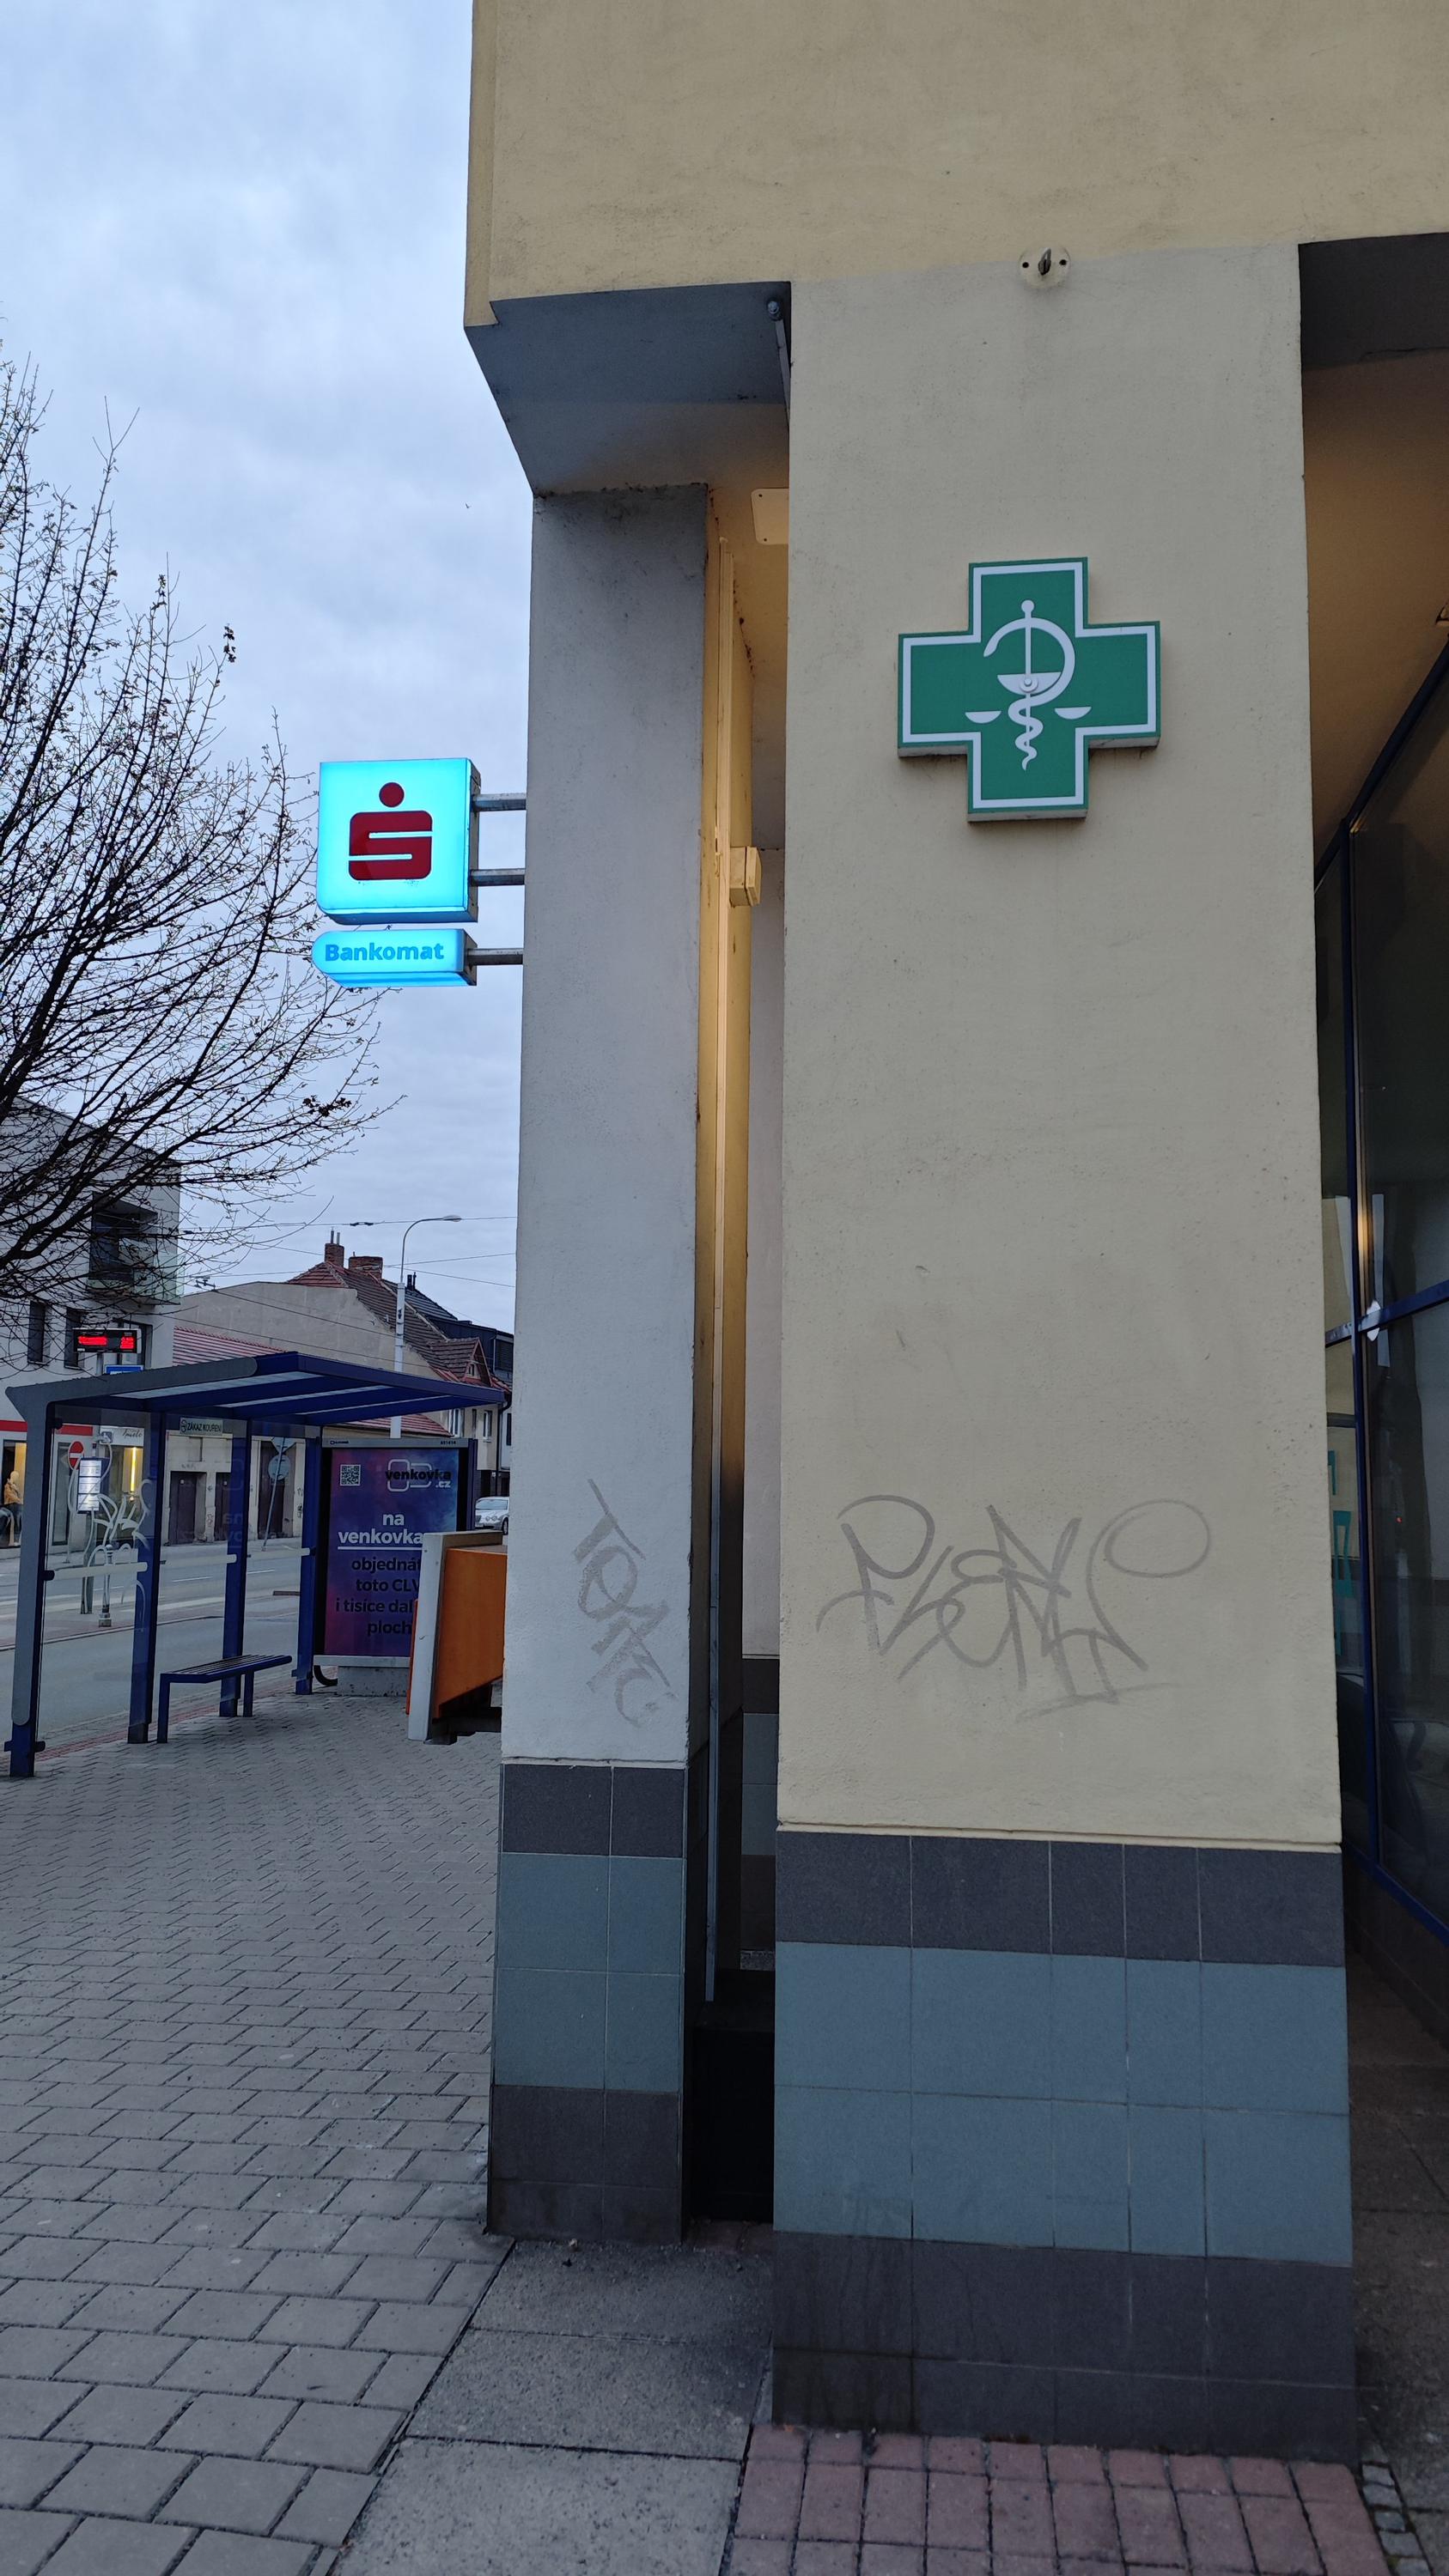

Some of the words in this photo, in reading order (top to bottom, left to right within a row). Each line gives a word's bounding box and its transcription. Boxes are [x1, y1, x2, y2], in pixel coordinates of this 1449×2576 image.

[325, 943, 444, 962] Bankomat
[385, 1469, 452, 1481] venkovka
[382, 1513, 405, 1526] na
[356, 1578, 389, 1592] toto
[336, 1598, 340, 1612] i
[344, 1598, 386, 1613] tisíce
